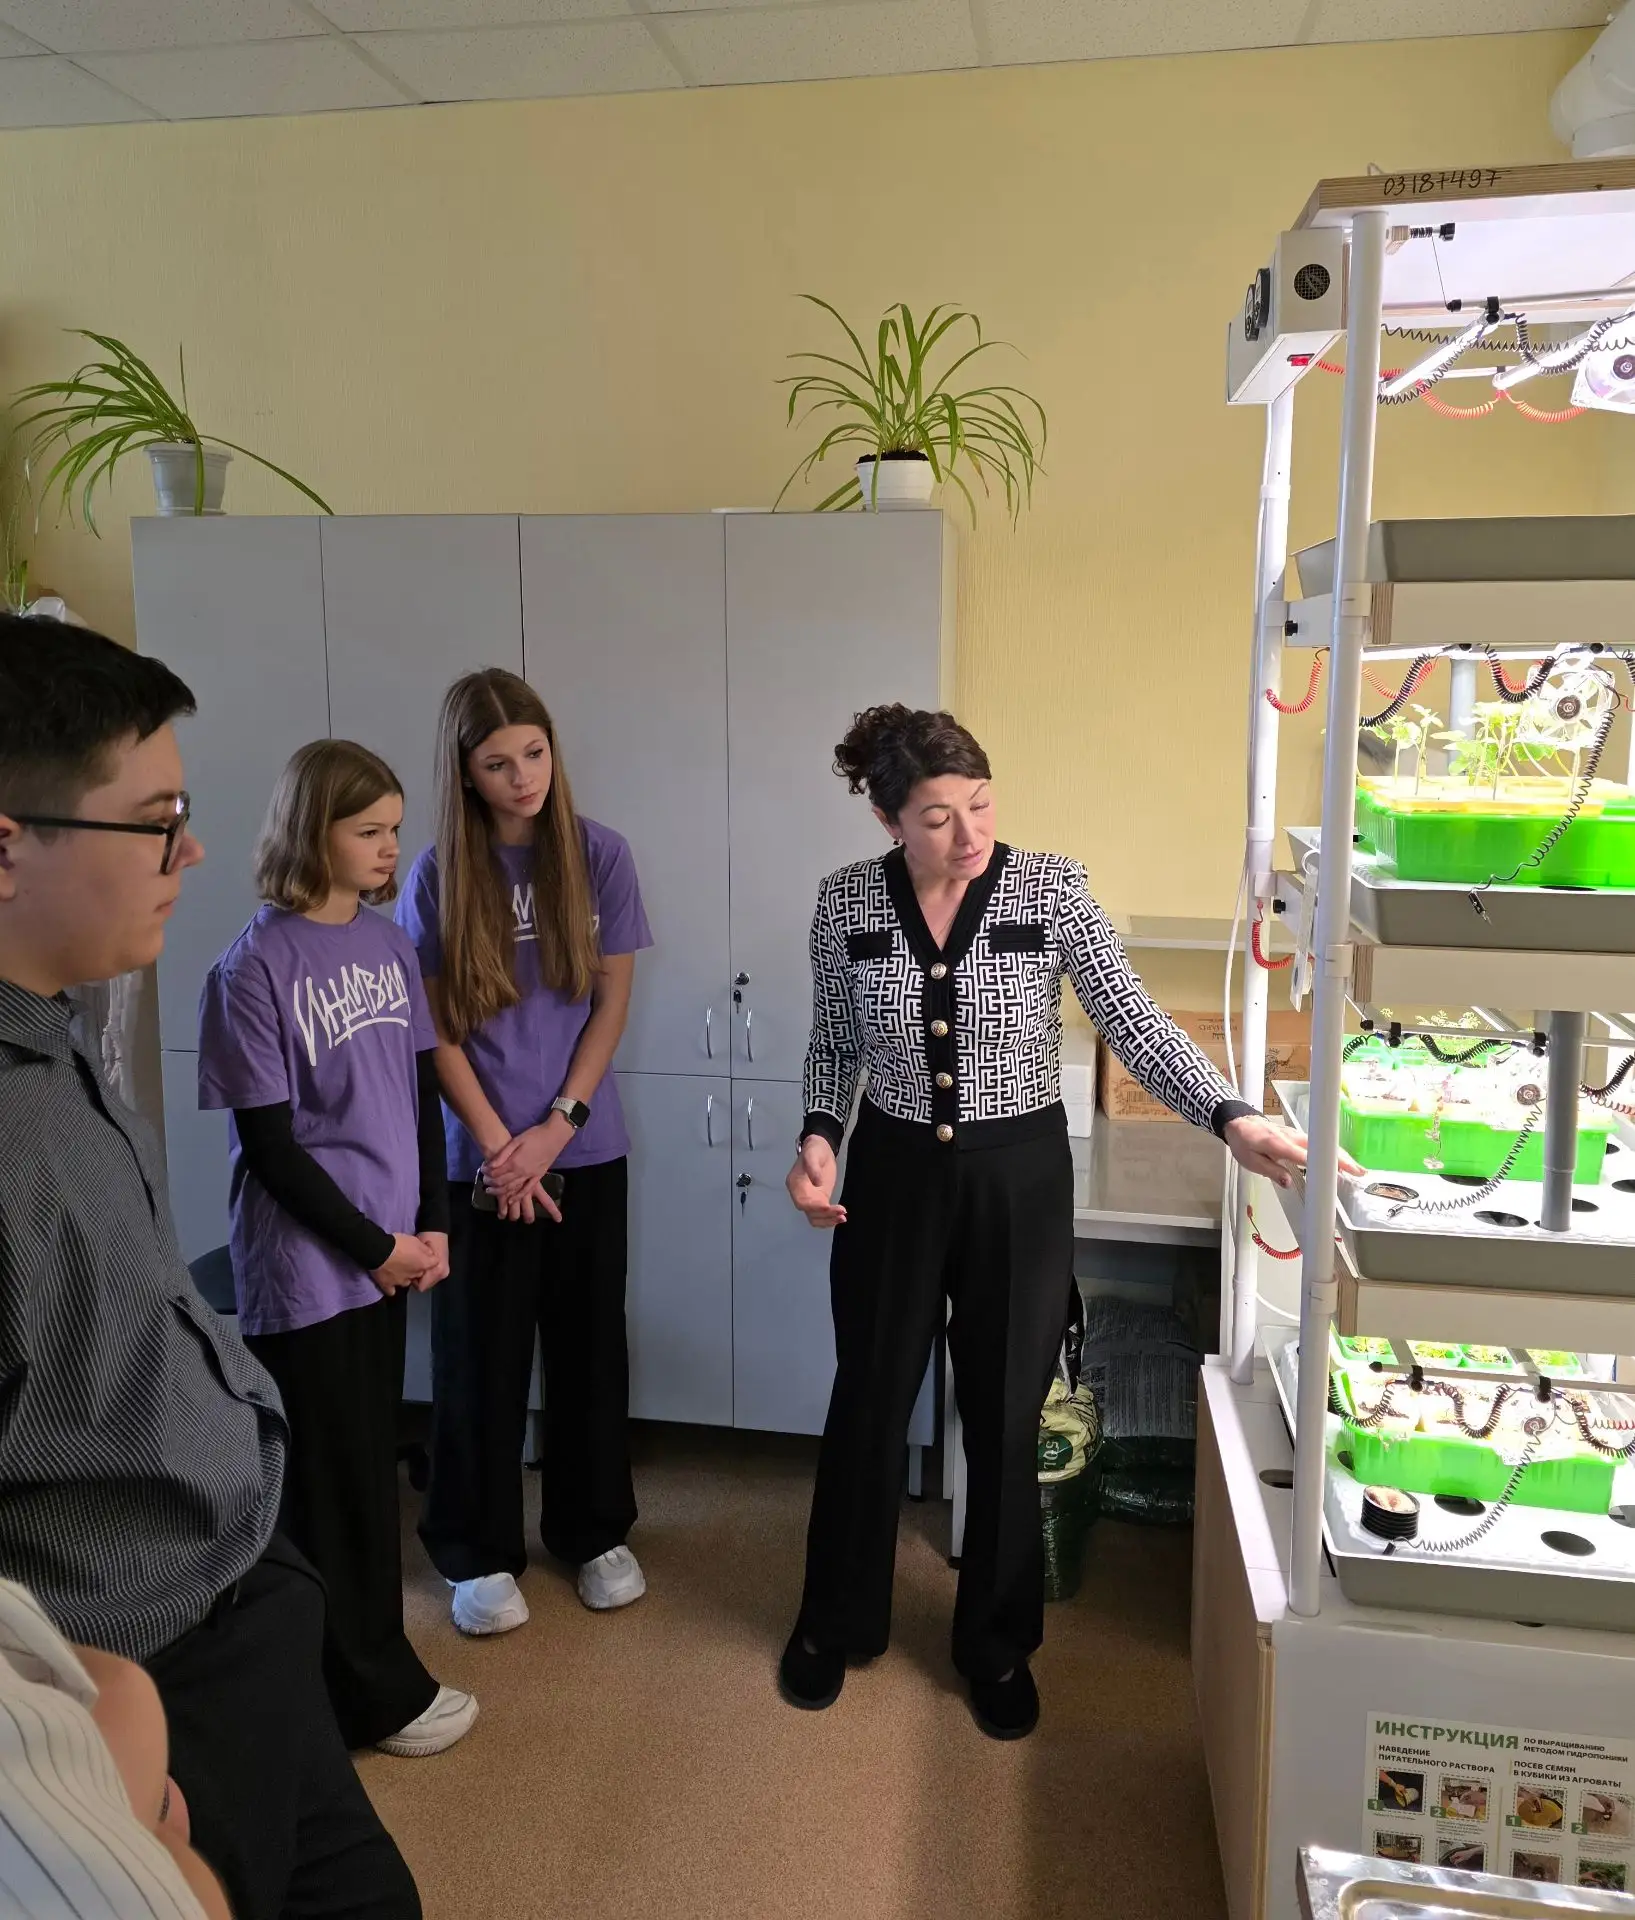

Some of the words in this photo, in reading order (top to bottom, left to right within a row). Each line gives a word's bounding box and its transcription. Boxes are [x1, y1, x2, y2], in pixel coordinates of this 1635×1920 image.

[1383, 168, 1511, 196] 03187497
[1375, 1720, 1519, 1750] ИНСТРУКЦИЯ
[1378, 1745, 1431, 1757] НАВЕДЕНИЕ
[1537, 1739, 1605, 1752] ВЫРАЩИВАНИЮ
[1523, 1745, 1565, 1756] МЕТОДОМ
[1566, 1750, 1628, 1763] ГИДРОПОНИКИ
[1378, 1754, 1448, 1768] ПИТАТЕЛЬНОГО
[1449, 1761, 1495, 1774] РАСТВОРА
[1513, 1760, 1543, 1770] ПОСЕВ
[1545, 1764, 1576, 1773] СЕМЯН
[1520, 1770, 1557, 1781] КУБИКИ
[1572, 1777, 1621, 1788] АГРОВАТЫ
[1433, 1807, 1442, 1817] 2
[1575, 1824, 1583, 1834] 2
